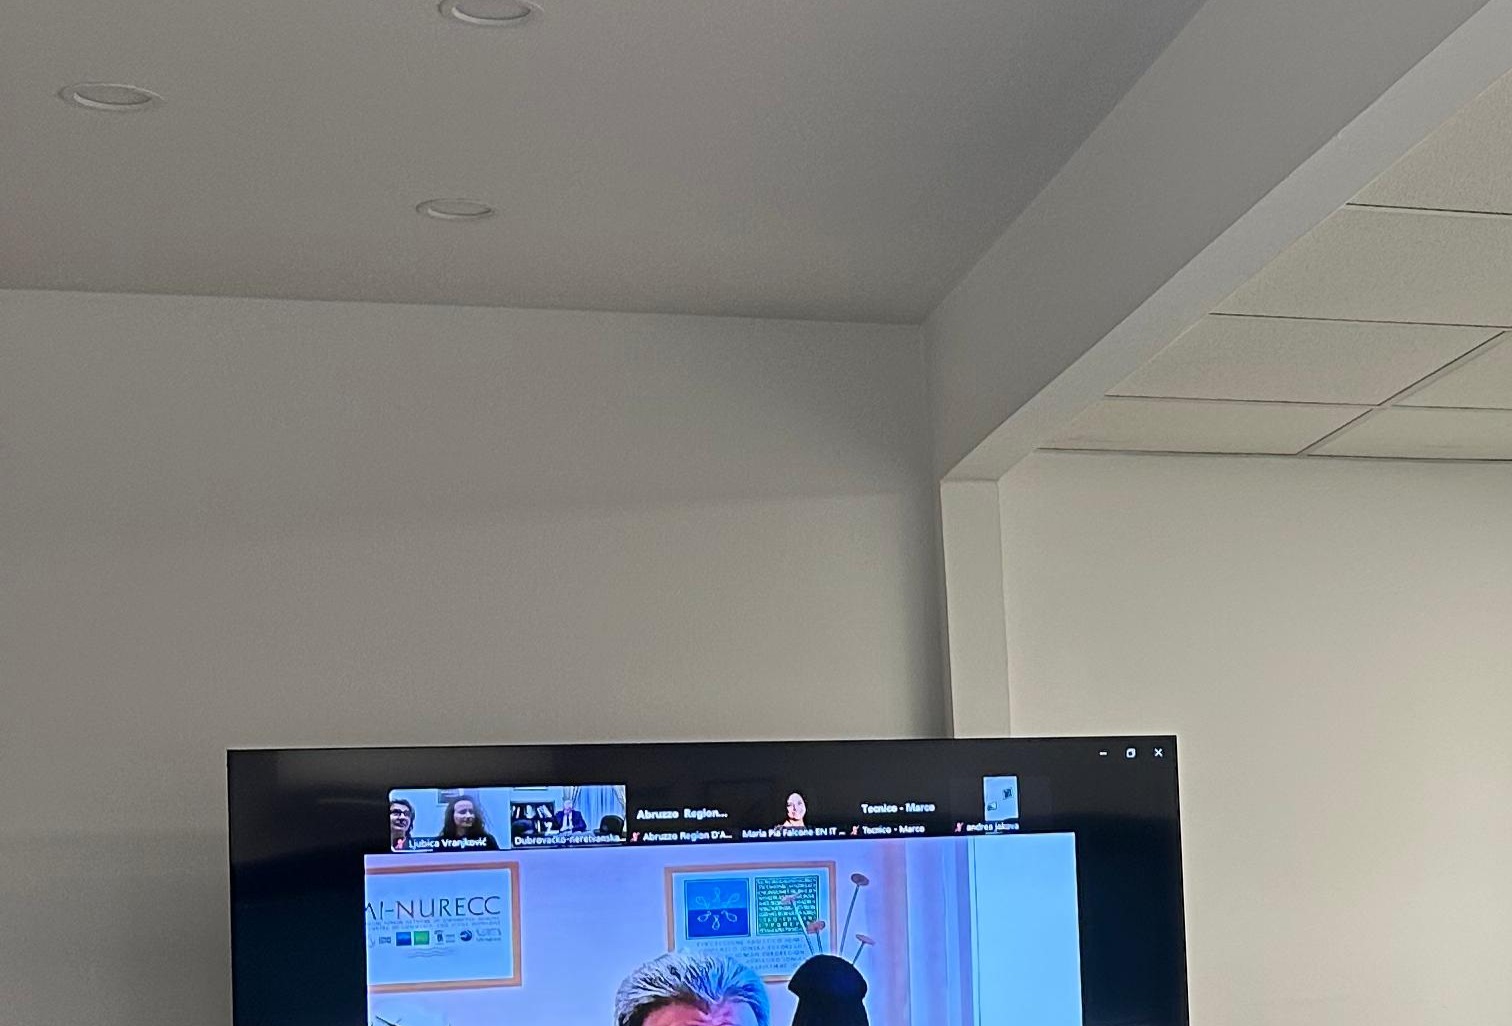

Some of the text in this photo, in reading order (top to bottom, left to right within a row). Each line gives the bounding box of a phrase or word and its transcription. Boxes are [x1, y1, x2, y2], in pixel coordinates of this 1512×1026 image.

[861, 803, 898, 814] Tecnico
[905, 803, 935, 813] Marco
[636, 810, 680, 820] Abruzzo
[642, 832, 678, 841] Abruzzo
[679, 831, 710, 842] Region
